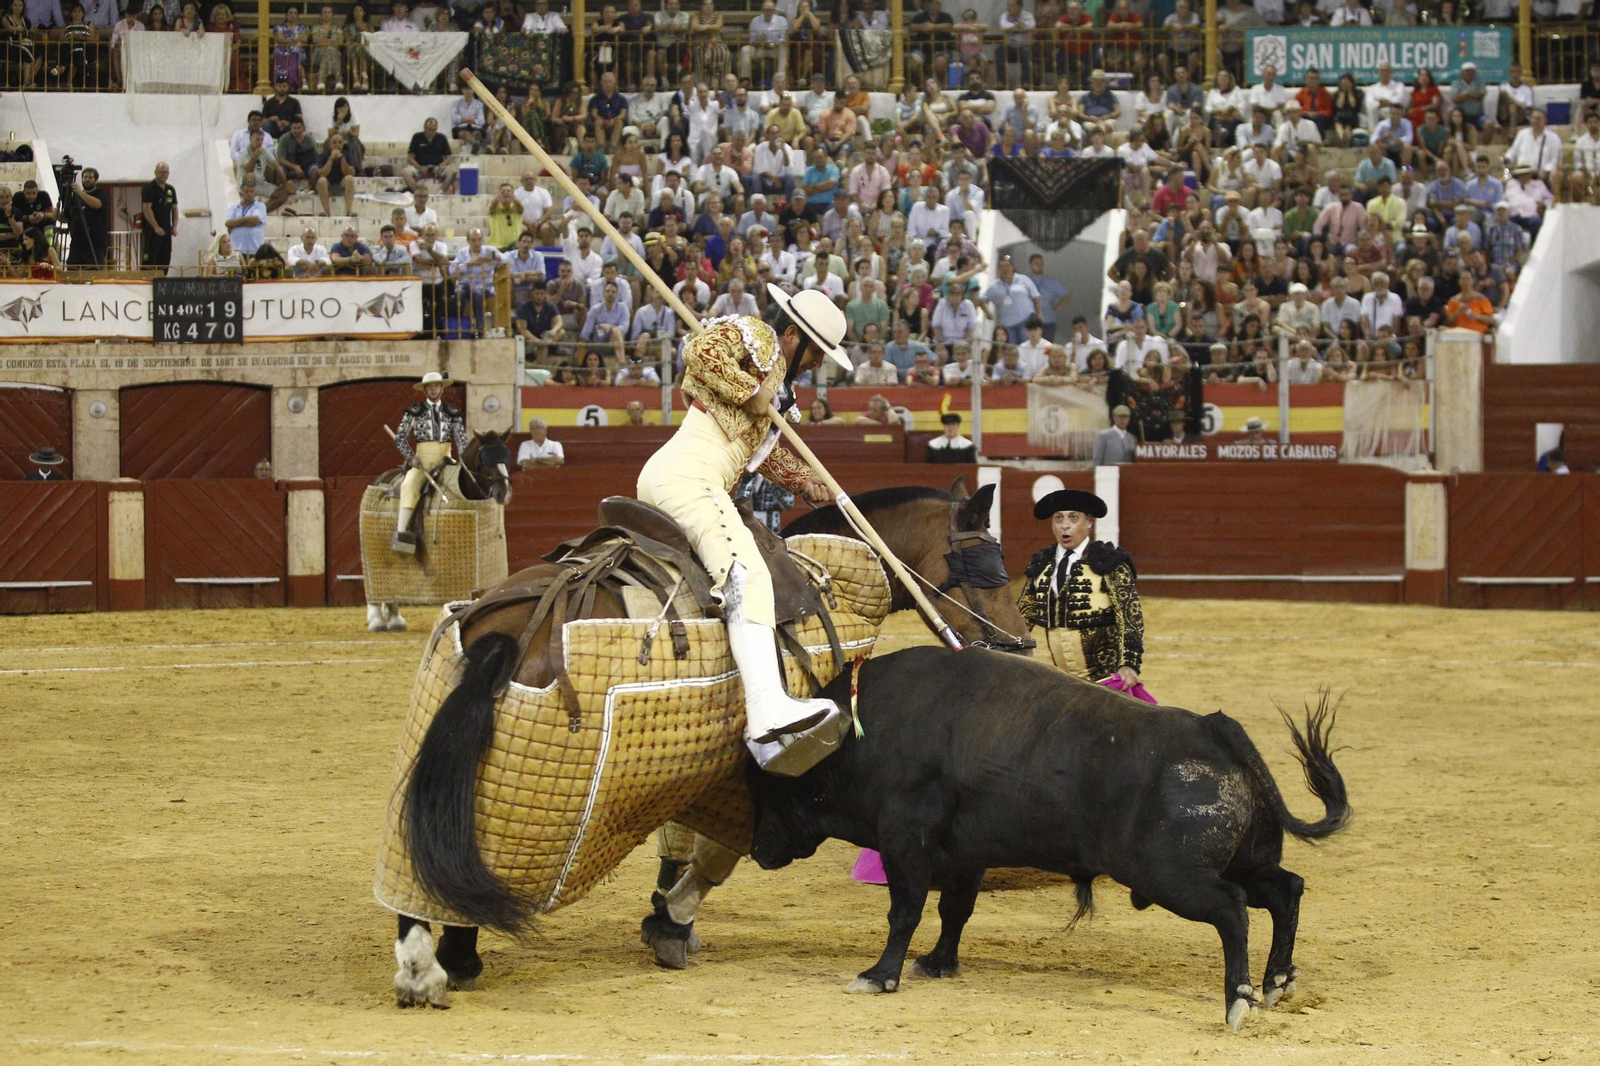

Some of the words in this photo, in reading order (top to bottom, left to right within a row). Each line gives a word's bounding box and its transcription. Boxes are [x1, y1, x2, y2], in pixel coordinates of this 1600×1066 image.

[1291, 43, 1334, 69] SAN
[1339, 42, 1449, 69] INDALECIO
[62, 299, 154, 322] LANCE
[242, 297, 342, 320] UTURO
[164, 322, 180, 339] KG
[187, 322, 235, 339] 470
[46, 358, 67, 368] ESTA
[70, 358, 96, 368] PLAZA
[100, 359, 111, 368] EL
[127, 358, 138, 368] DE
[143, 357, 197, 368] SEPTIEMBRE
[201, 357, 212, 367] DE
[215, 357, 234, 367] 1887
[238, 357, 248, 366] SE
[340, 354, 372, 364] AGOSTO
[375, 354, 386, 364] DE
[584, 408, 600, 426] 5
[1136, 445, 1207, 458] MAYORALES
[1218, 445, 1260, 458] MOZOS
[1263, 445, 1278, 458] DE
[1281, 445, 1337, 458] CABALLOS
